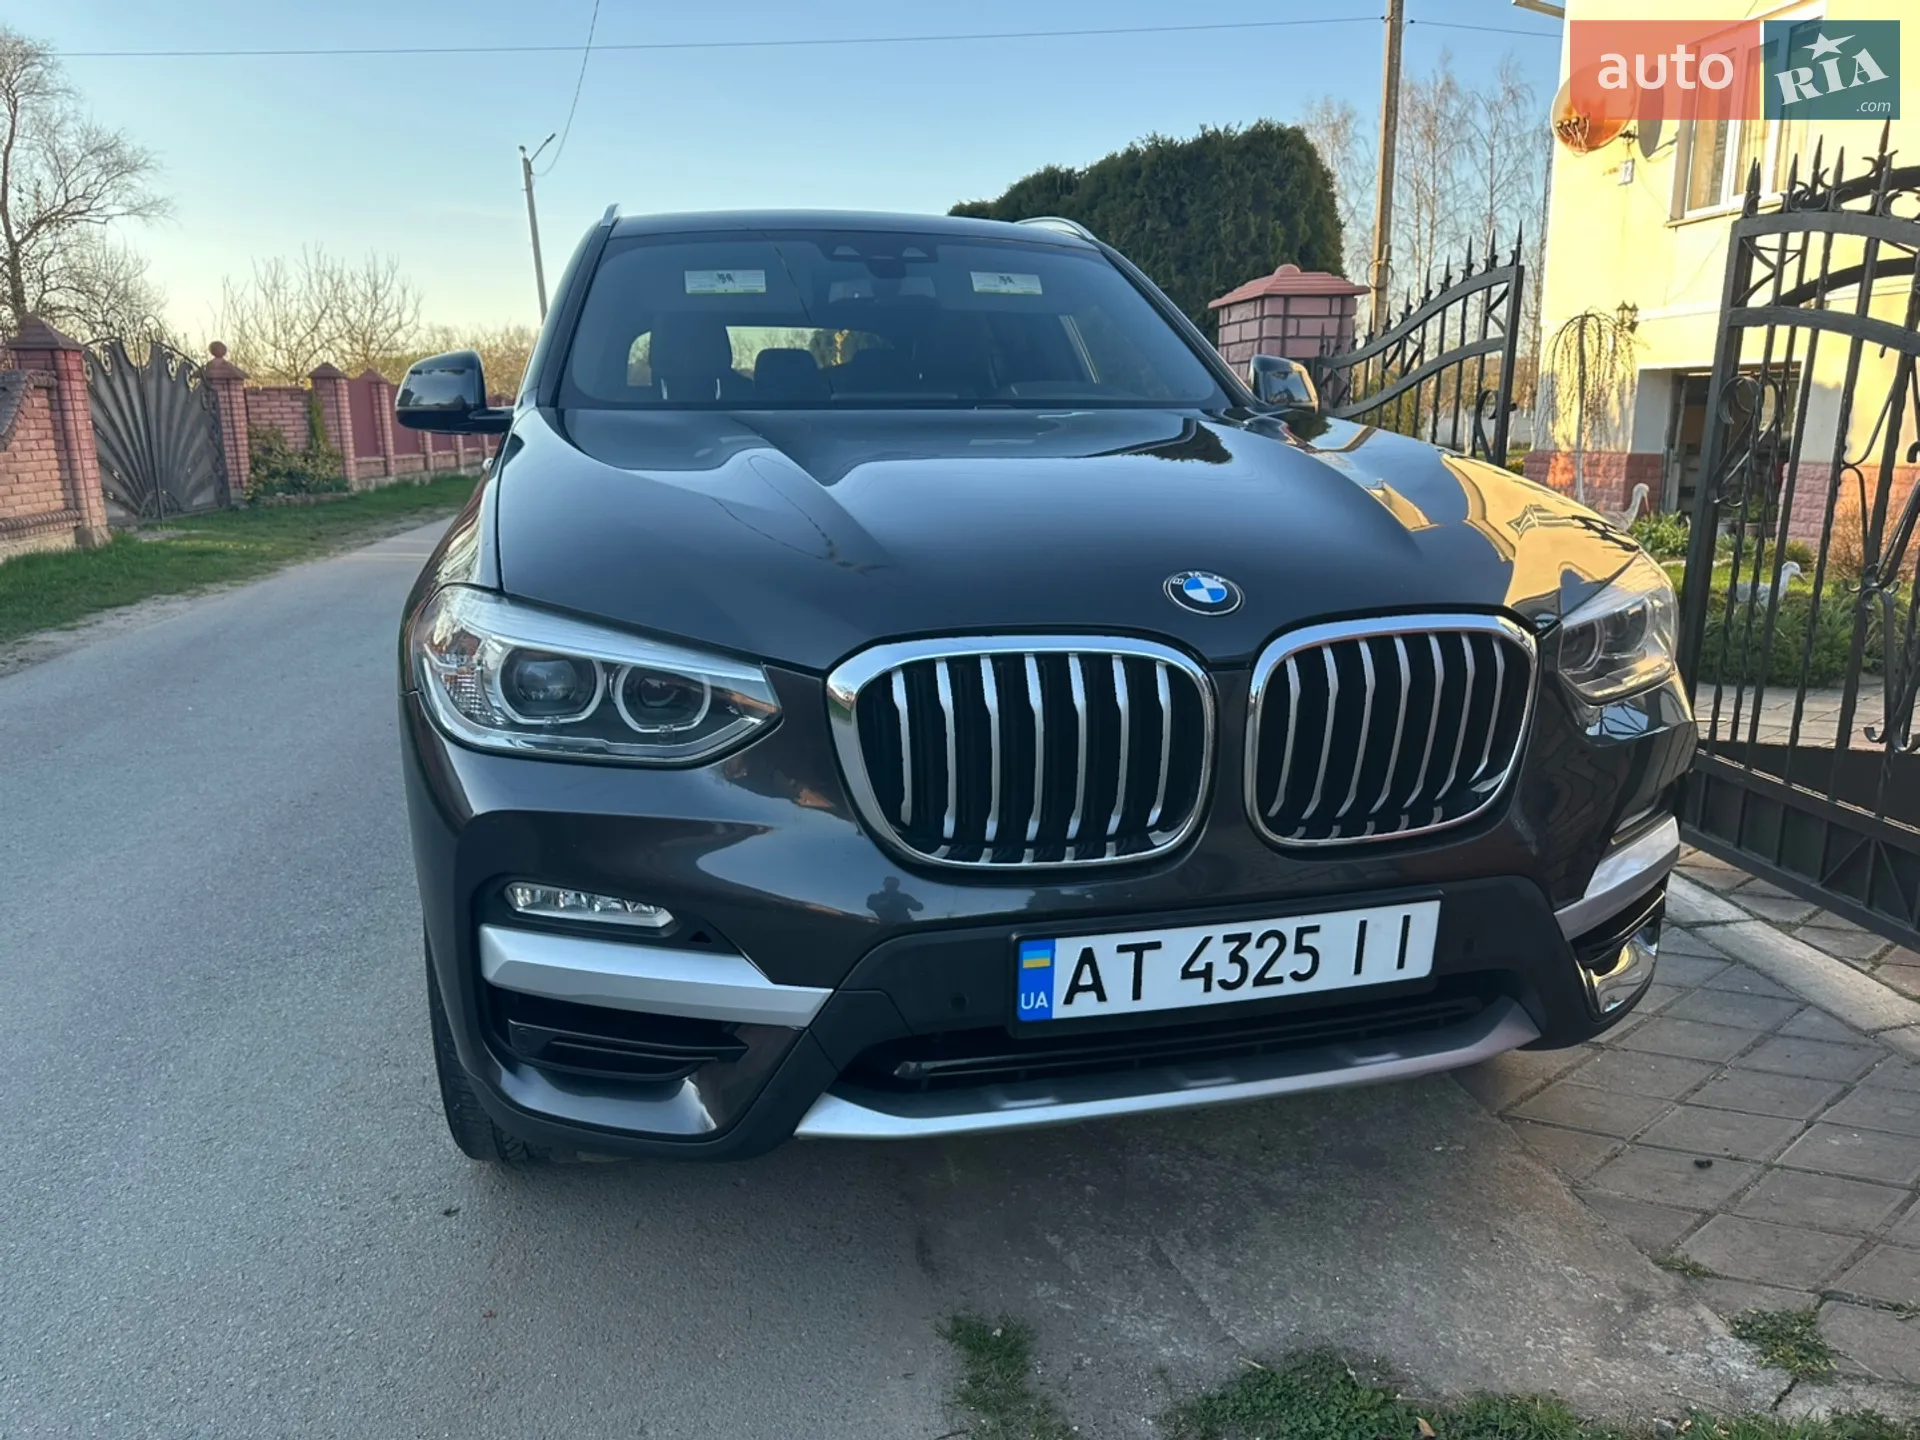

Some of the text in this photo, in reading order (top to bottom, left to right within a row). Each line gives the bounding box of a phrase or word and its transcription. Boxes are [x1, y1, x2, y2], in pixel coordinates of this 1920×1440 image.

[1063, 941, 1163, 1005] AT
[1180, 925, 1321, 993] 4325
[1020, 992, 1049, 1011] UA
